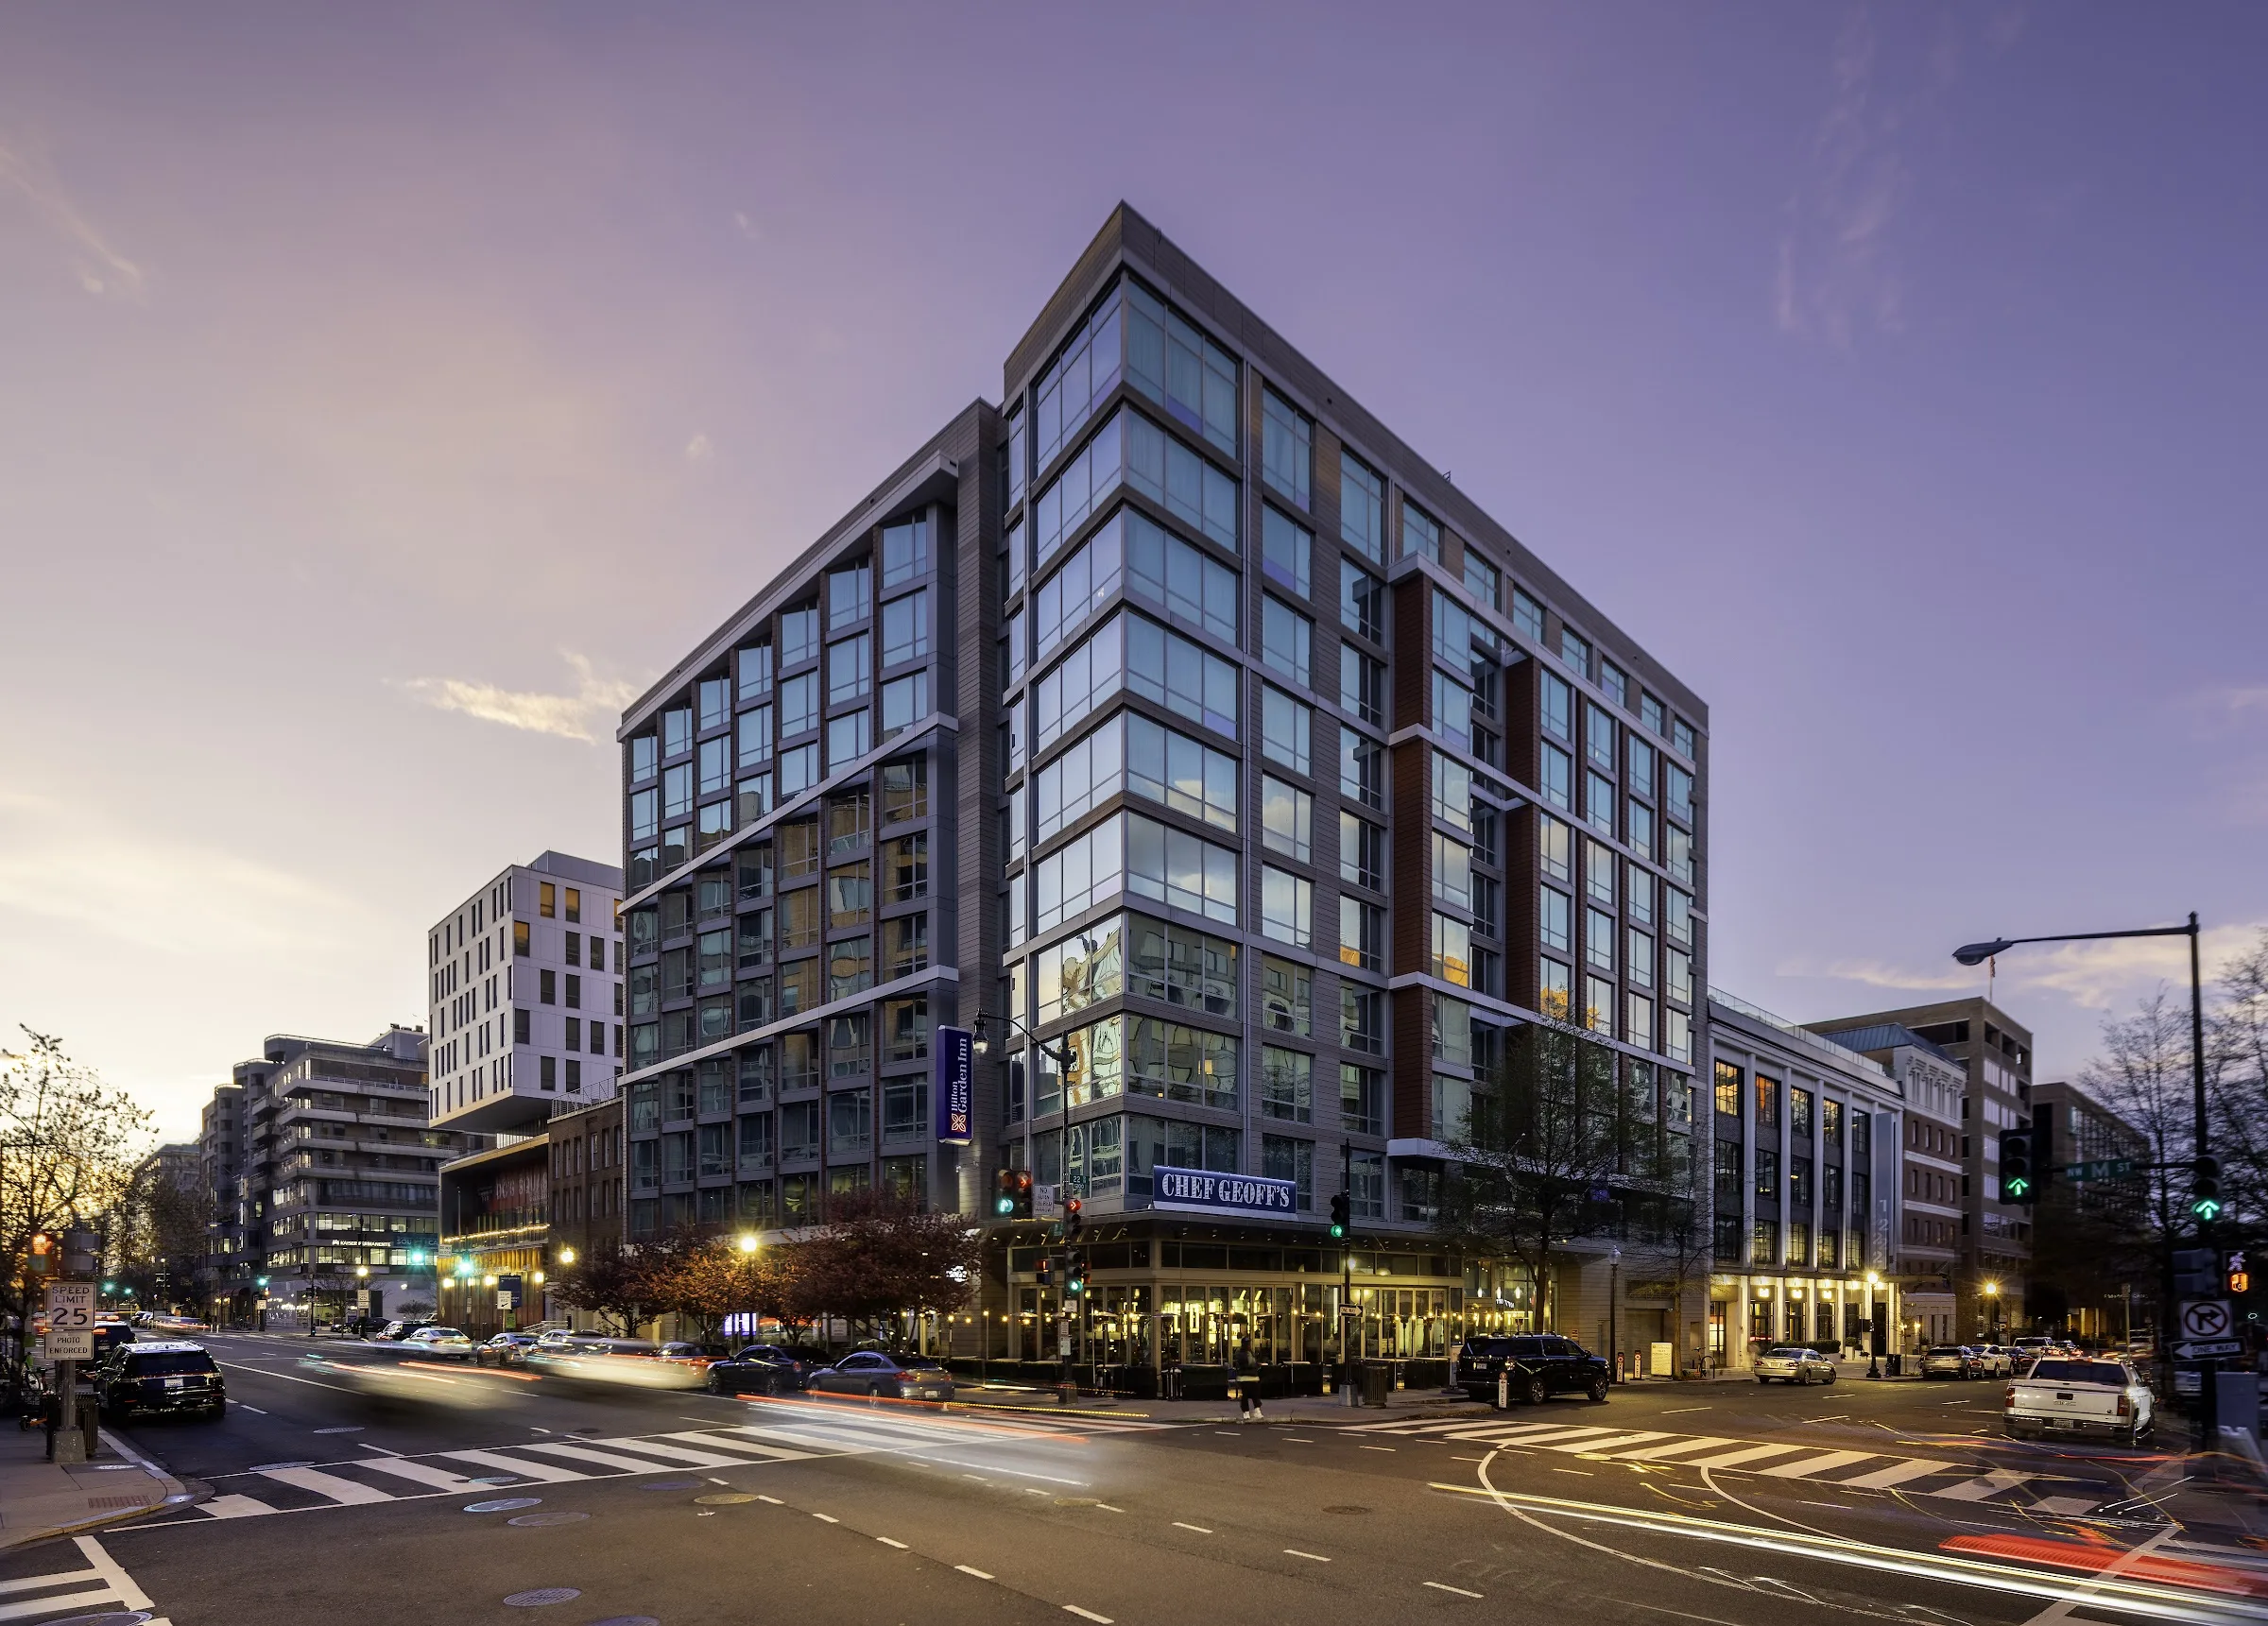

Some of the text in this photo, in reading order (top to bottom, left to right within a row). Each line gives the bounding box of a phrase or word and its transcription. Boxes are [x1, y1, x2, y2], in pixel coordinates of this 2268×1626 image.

[957, 1038, 968, 1113] Garden Inn
[2067, 1162, 2132, 1177] NW M ST
[1161, 1172, 1290, 1207] CHEF GEOFF'S
[52, 1286, 90, 1294] SPEED
[55, 1295, 86, 1304] LIMIT
[53, 1307, 88, 1326] 25
[2192, 1343, 2238, 1354] ONE WAY
